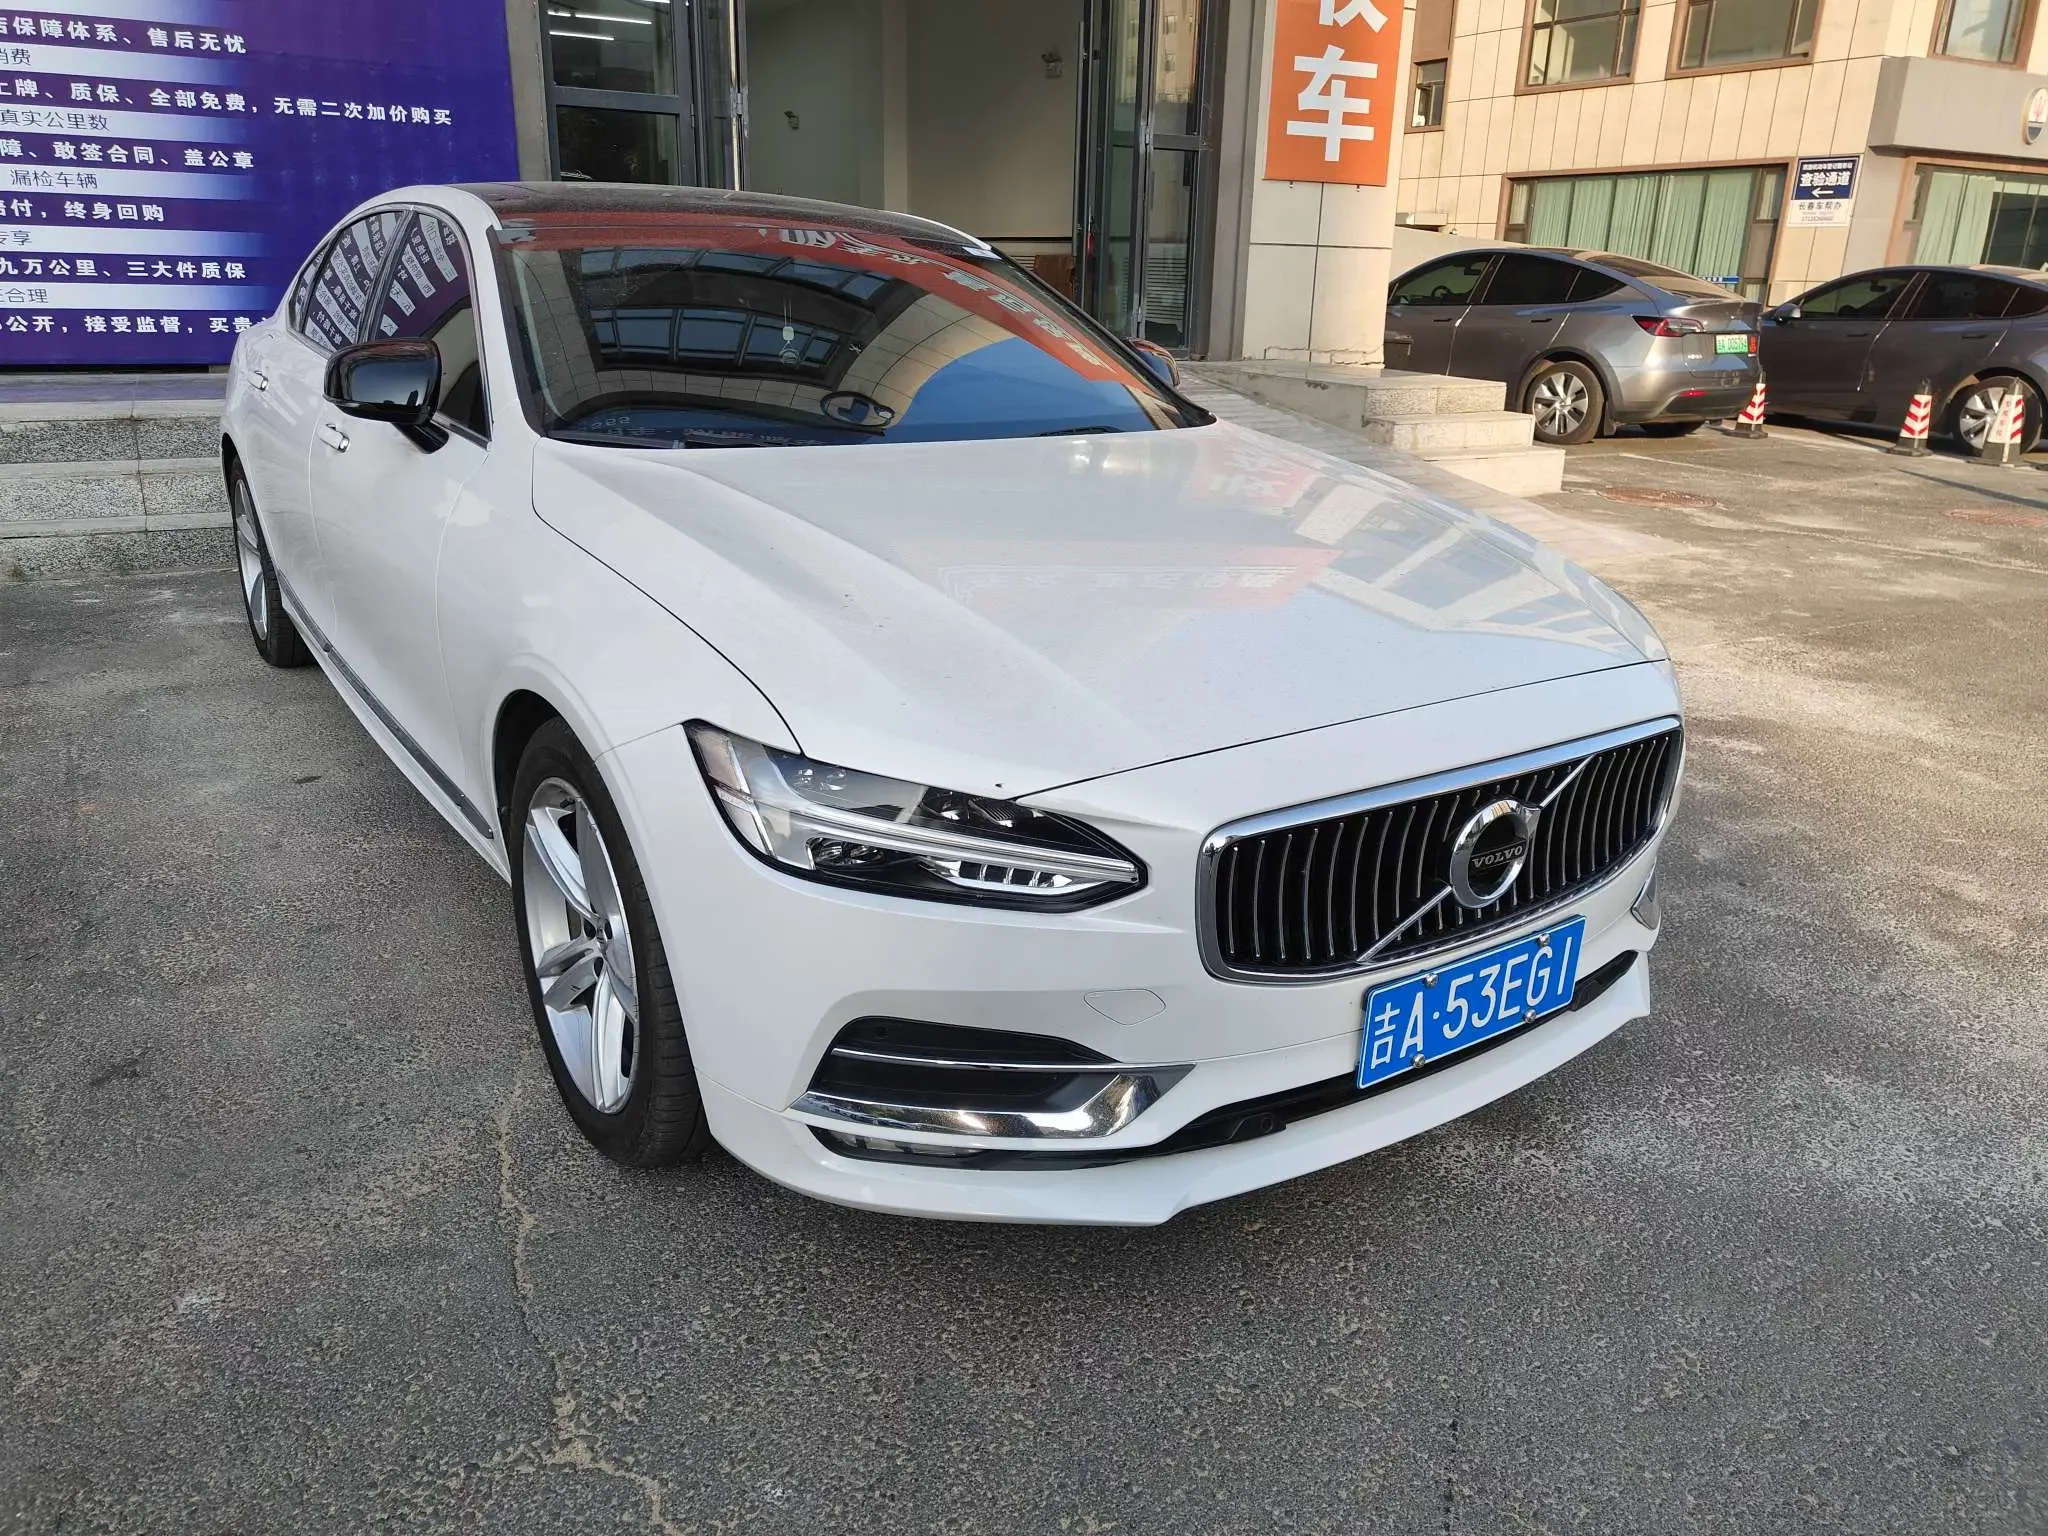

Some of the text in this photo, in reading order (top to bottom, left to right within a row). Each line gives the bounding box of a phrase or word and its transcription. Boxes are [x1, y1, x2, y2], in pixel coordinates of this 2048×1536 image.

[10, 168, 98, 189] 漏检车辆
[1800, 171, 1851, 187] 查验通道
[0, 257, 247, 279] 九万公里、三大件质保
[0, 288, 49, 303] 合理
[0, 316, 270, 334] 公开，接受监督，买贵
[1471, 845, 1523, 868] VOLVO
